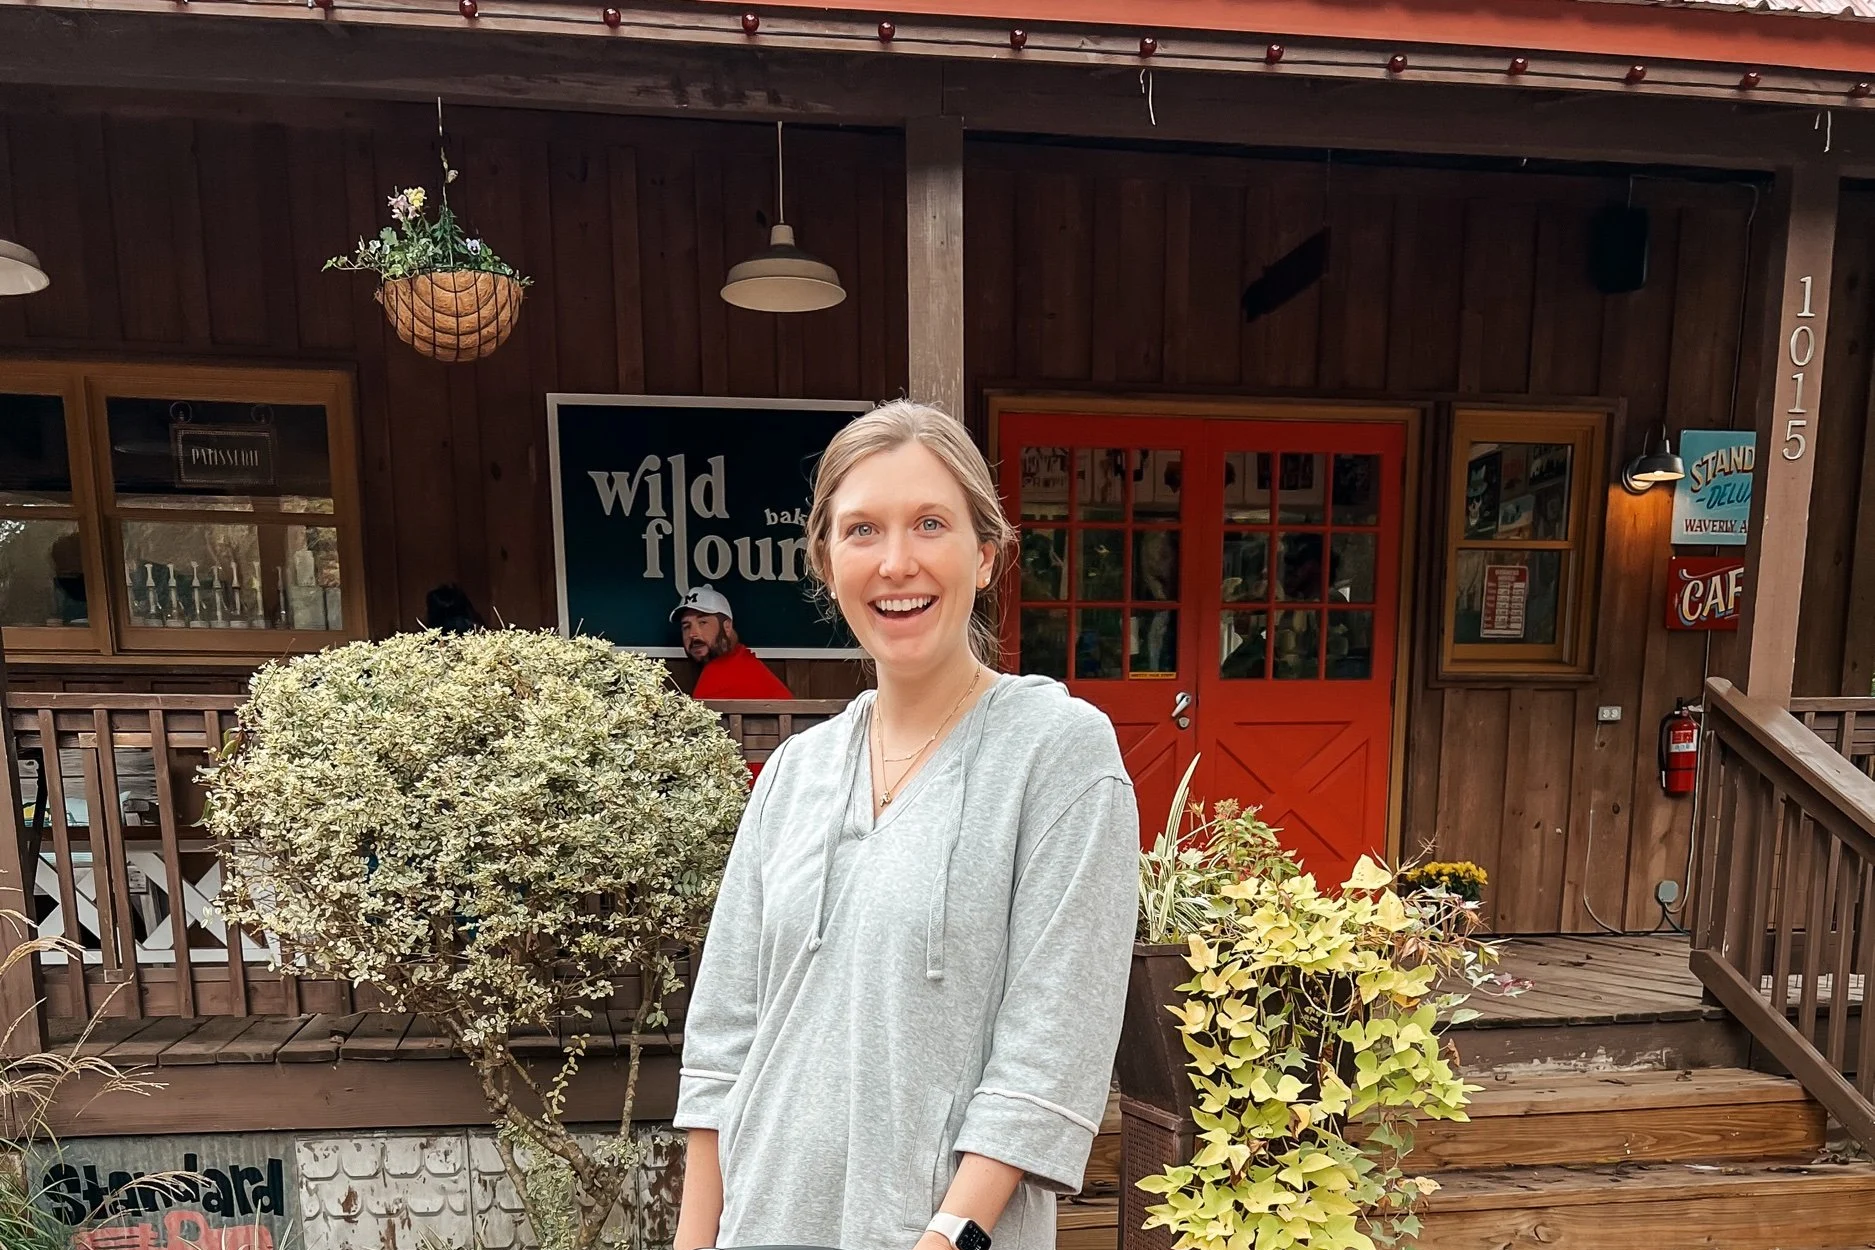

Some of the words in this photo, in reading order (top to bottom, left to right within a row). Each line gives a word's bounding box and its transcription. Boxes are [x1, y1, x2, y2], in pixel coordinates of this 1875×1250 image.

[1782, 275, 1816, 460] 1015
[587, 454, 730, 519] wild
[1690, 446, 1755, 493] STAND
[764, 508, 808, 527] bak
[1684, 518, 1737, 533] WAVERLY
[641, 517, 808, 598] flour
[684, 592, 699, 605] M
[1681, 567, 1744, 613] CAF
[42, 1153, 285, 1227] Standard
